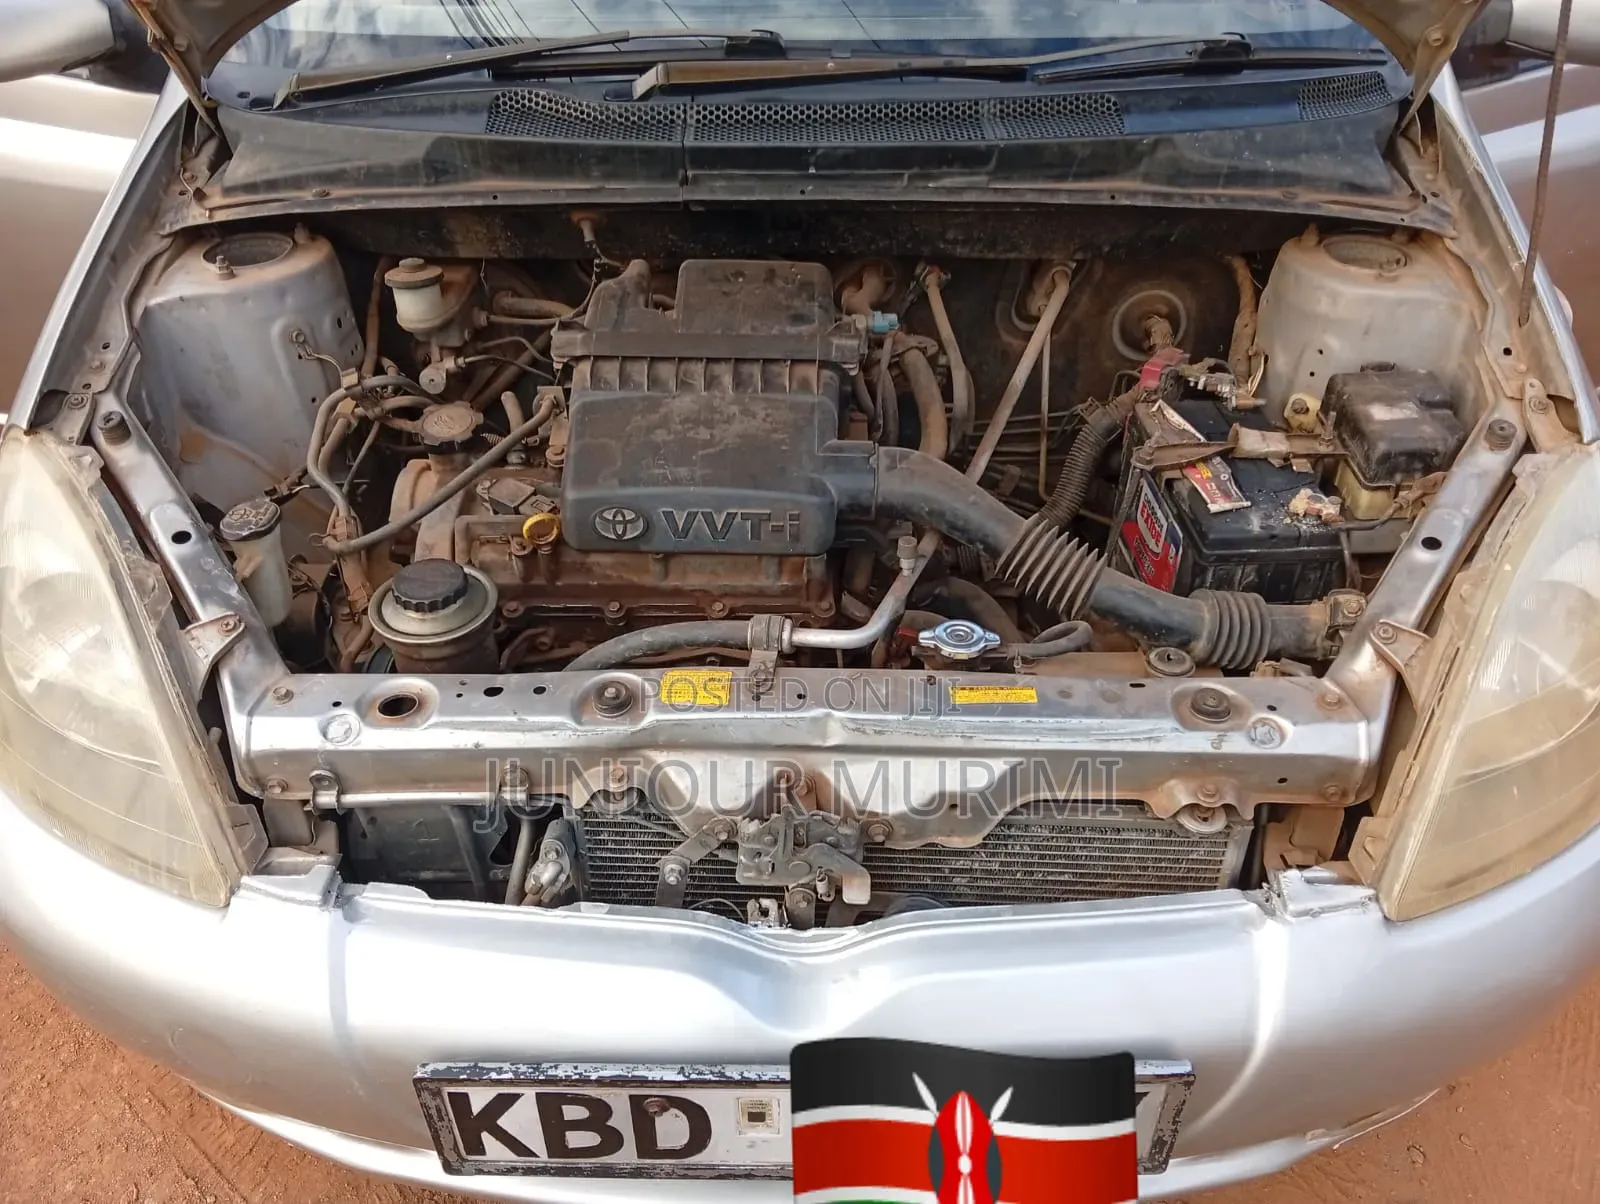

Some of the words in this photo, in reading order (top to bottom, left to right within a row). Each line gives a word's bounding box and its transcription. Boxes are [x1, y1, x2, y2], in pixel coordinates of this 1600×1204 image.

[660, 508, 800, 542] VVT-i
[1139, 500, 1163, 548] EXIDE
[447, 1092, 712, 1160] KBD
